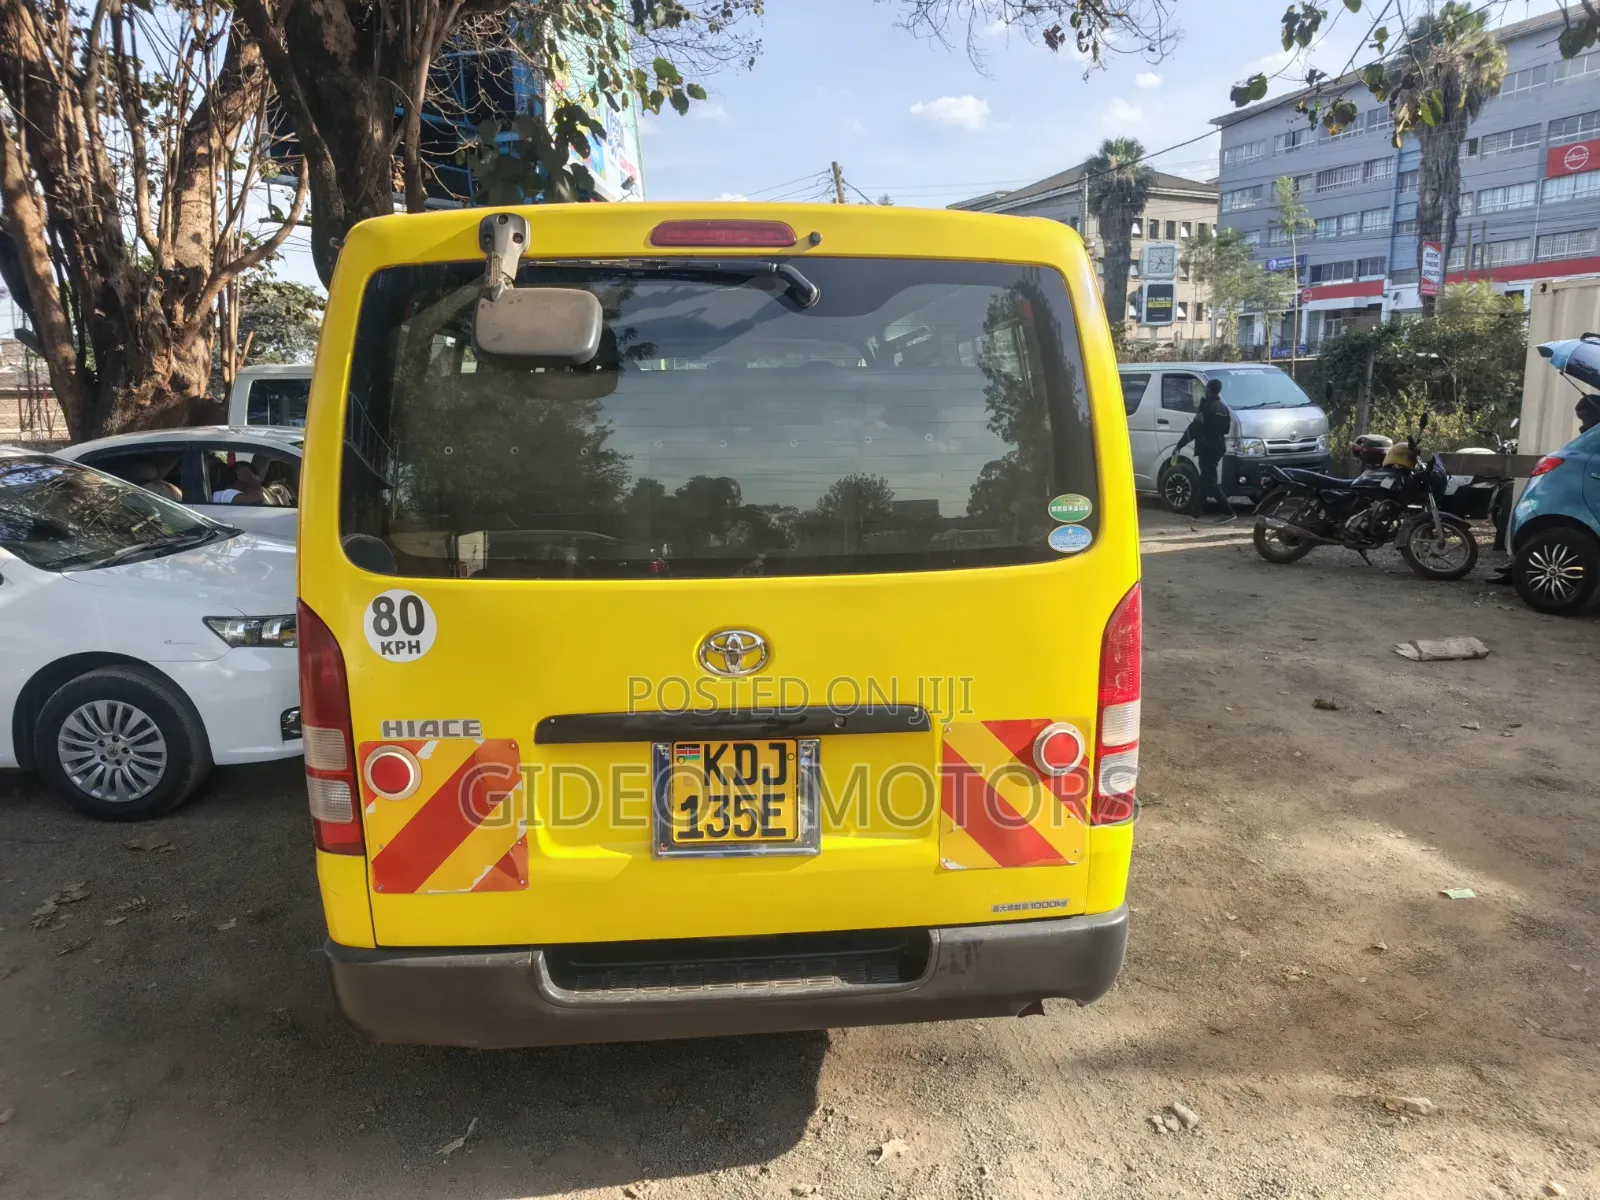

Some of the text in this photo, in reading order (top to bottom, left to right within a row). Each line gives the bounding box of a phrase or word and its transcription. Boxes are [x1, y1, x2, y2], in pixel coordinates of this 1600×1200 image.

[372, 595, 425, 637] 80
[380, 640, 421, 656] KPH
[382, 719, 482, 738] HIACE
[703, 742, 787, 787] KDJ
[677, 792, 787, 839] 135E
